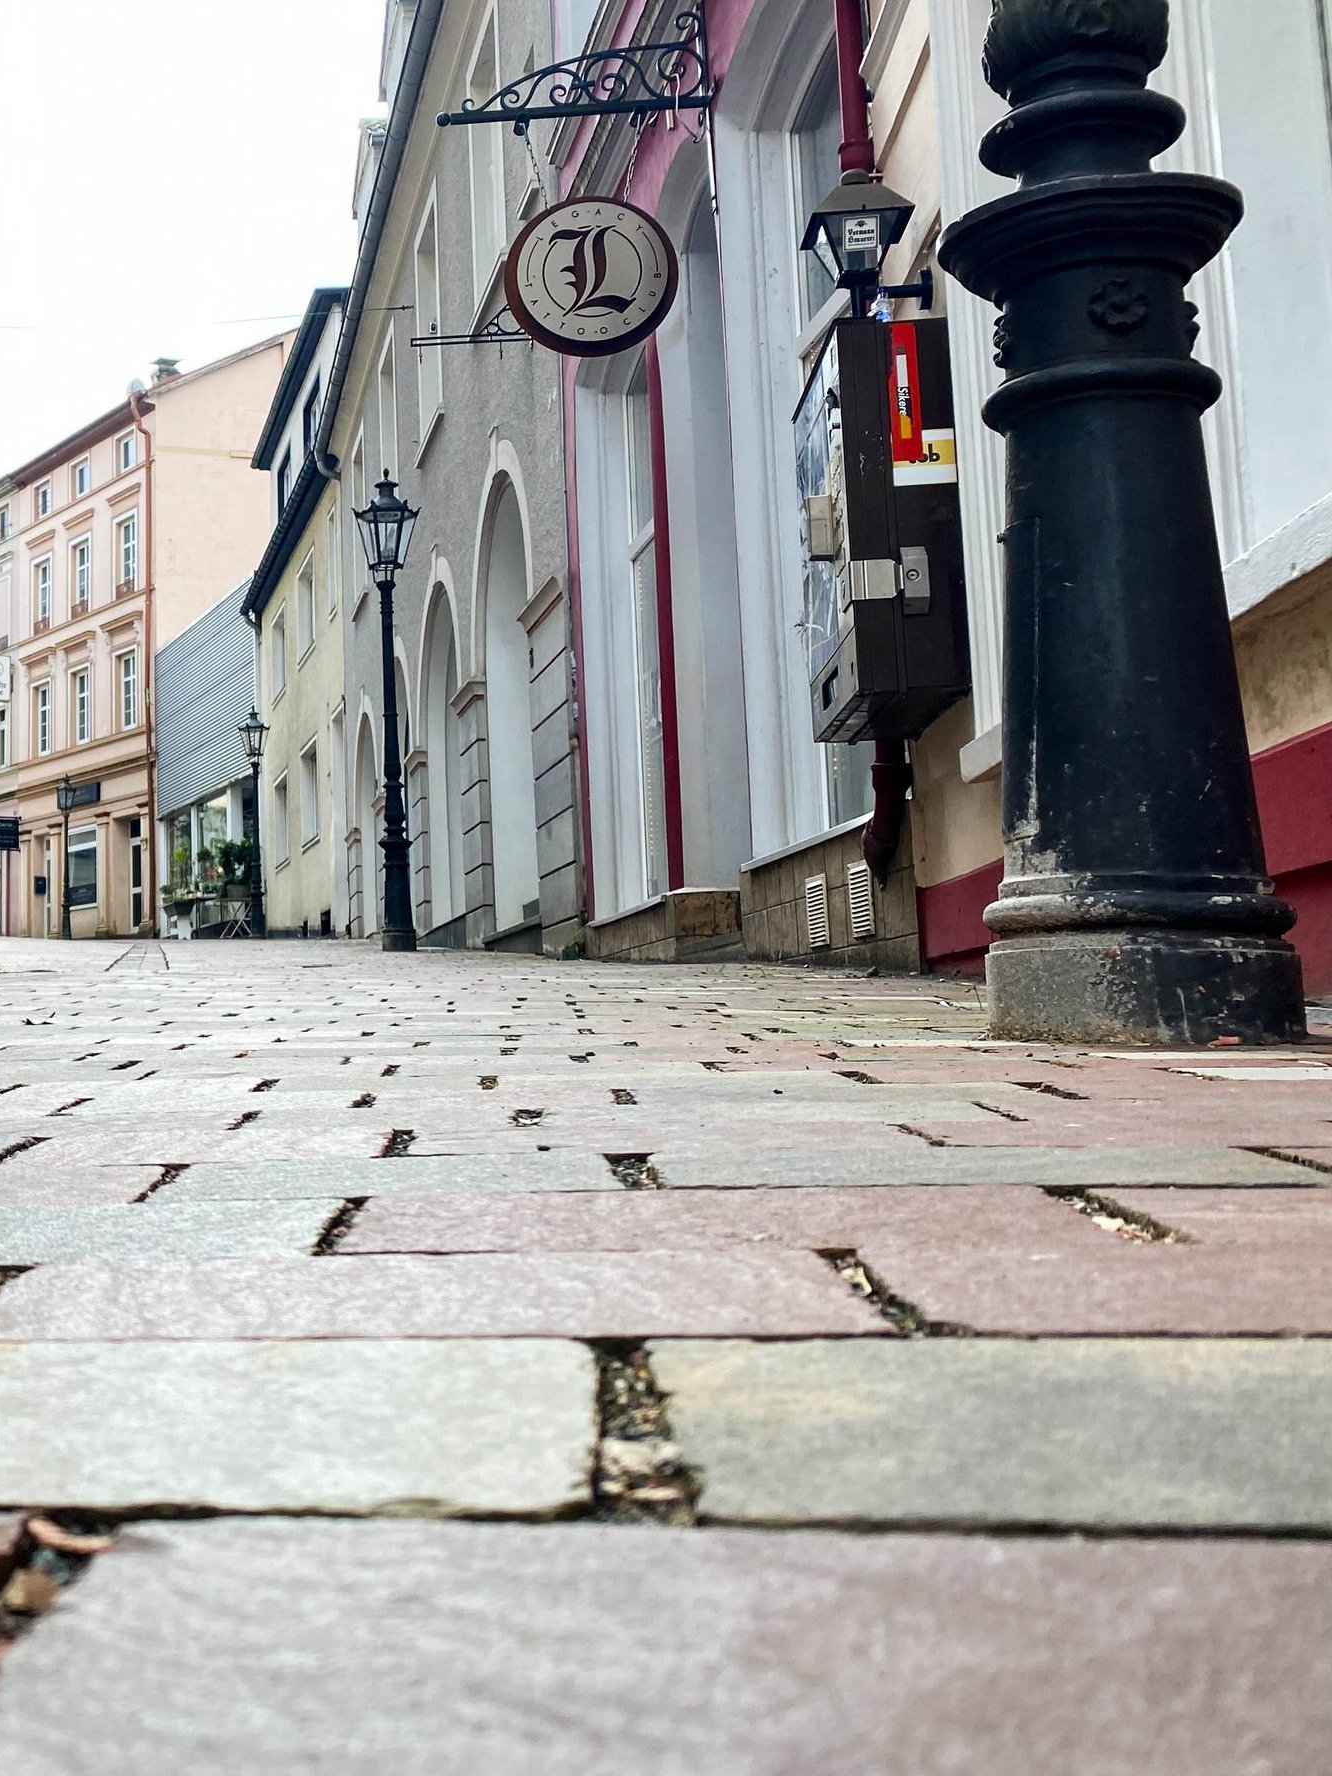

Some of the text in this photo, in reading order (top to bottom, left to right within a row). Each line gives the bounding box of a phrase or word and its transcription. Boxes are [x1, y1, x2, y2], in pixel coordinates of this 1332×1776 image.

[536, 208, 643, 242] LEGACY
[549, 224, 637, 317] L
[525, 273, 662, 335] TATTOO CLUB
